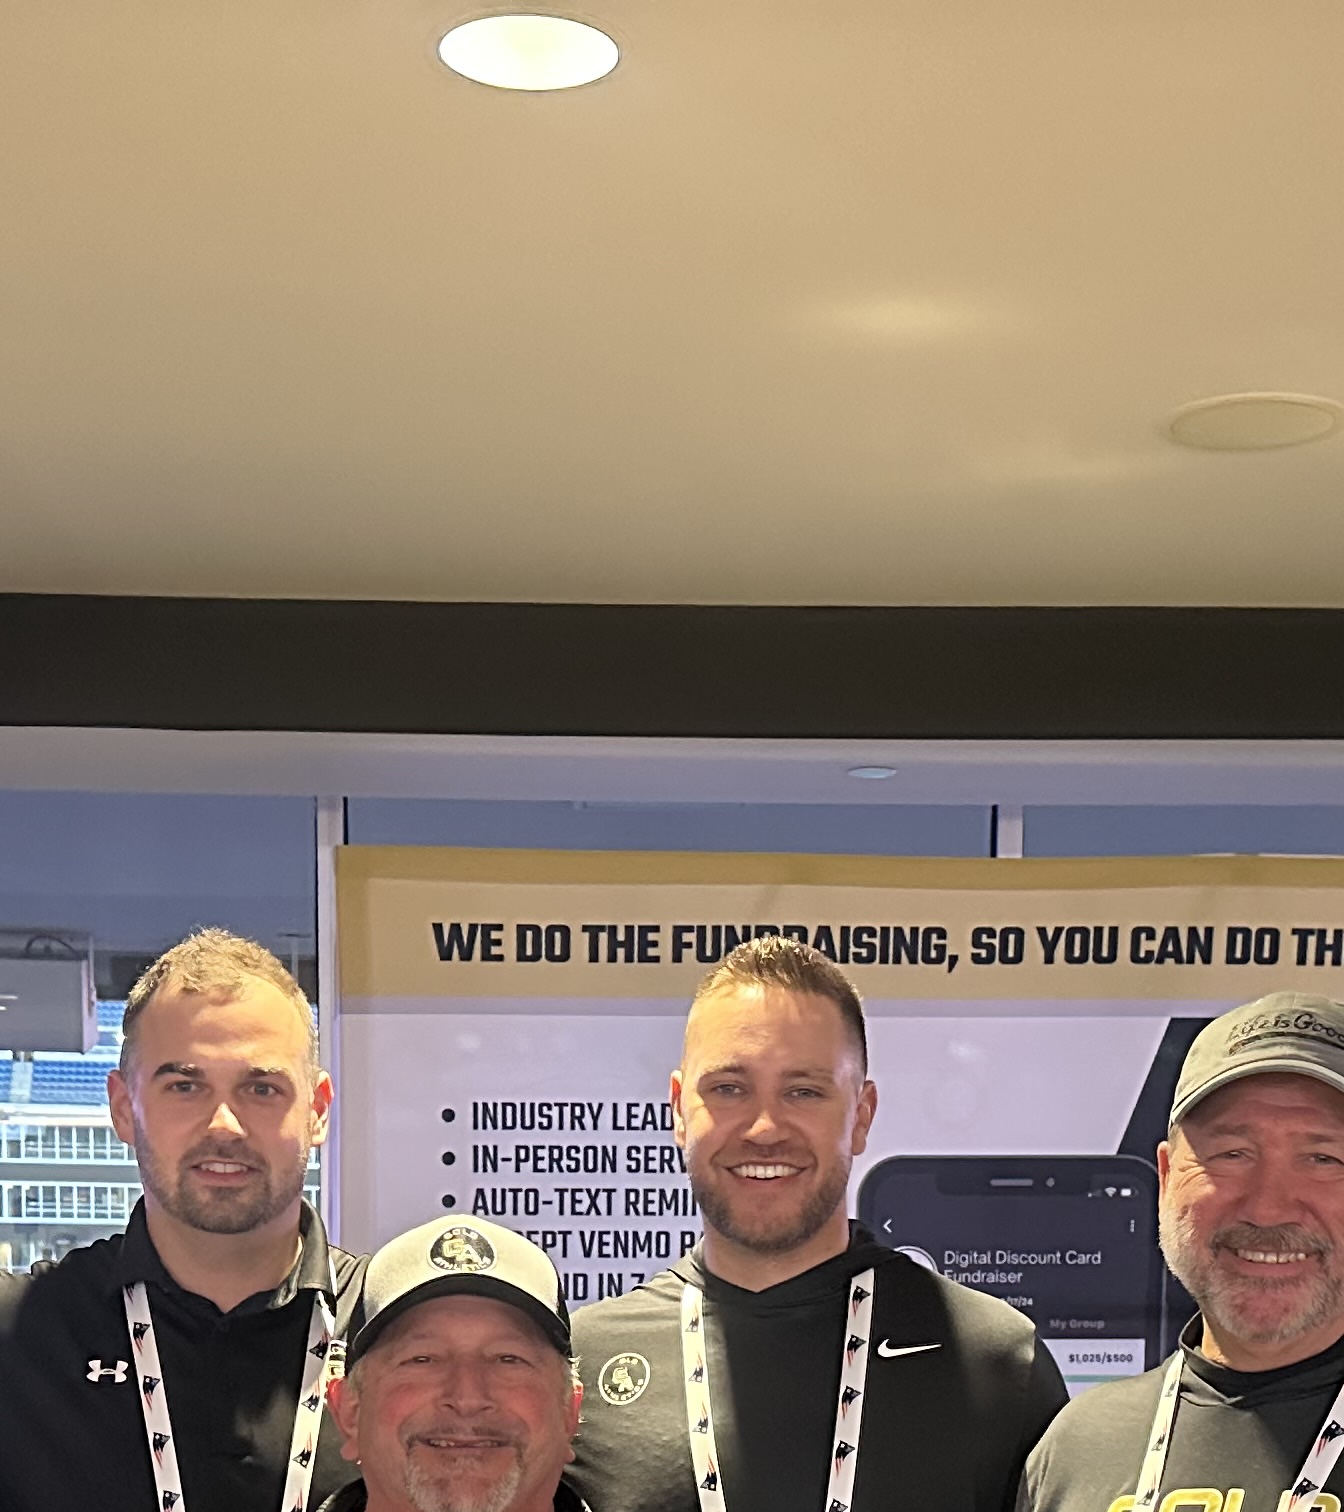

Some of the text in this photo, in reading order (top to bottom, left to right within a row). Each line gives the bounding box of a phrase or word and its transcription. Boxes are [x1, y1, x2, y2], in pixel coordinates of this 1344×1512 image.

[431, 922, 504, 961] WE
[516, 923, 570, 962] DO
[582, 924, 660, 963] THE
[971, 926, 1024, 965] SO
[1037, 926, 1119, 965] YOU
[1130, 926, 1215, 966] CAN
[1226, 926, 1280, 966] DO
[471, 1102, 604, 1131] INDUSTRY
[471, 1144, 618, 1173] IN-PERSON
[471, 1187, 617, 1217] AUTO-TEXT
[517, 1230, 572, 1259] EPT
[579, 1230, 671, 1258] VENMO
[944, 1250, 1102, 1266] Digital Discount Card
[944, 1269, 1023, 1284] Fundraiser
